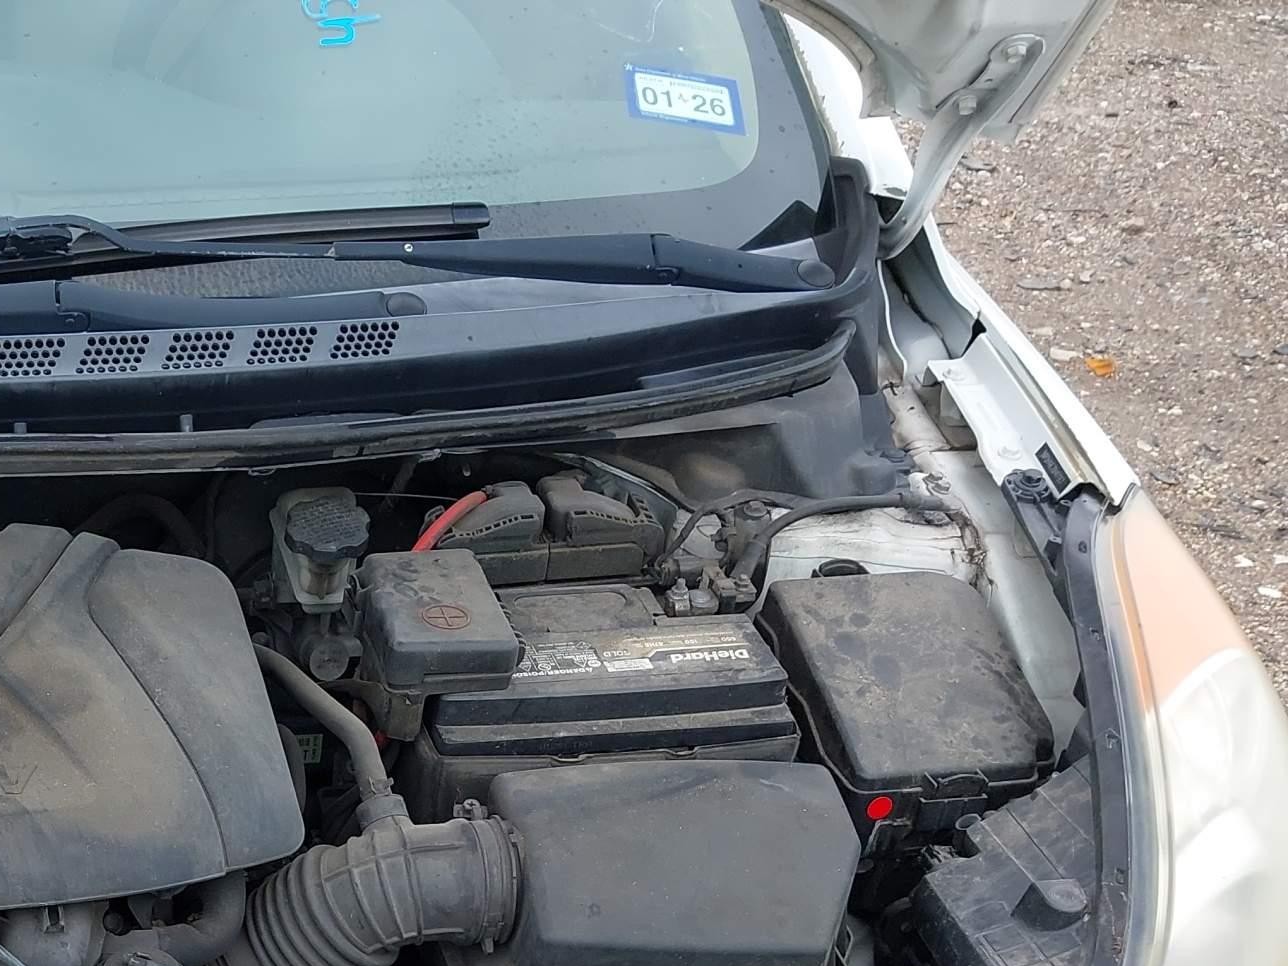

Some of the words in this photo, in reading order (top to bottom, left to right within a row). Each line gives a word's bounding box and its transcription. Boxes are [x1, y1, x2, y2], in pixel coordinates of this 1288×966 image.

[642, 87, 673, 108] 01
[692, 95, 726, 117] 26
[670, 649, 749, 664] DieHard
